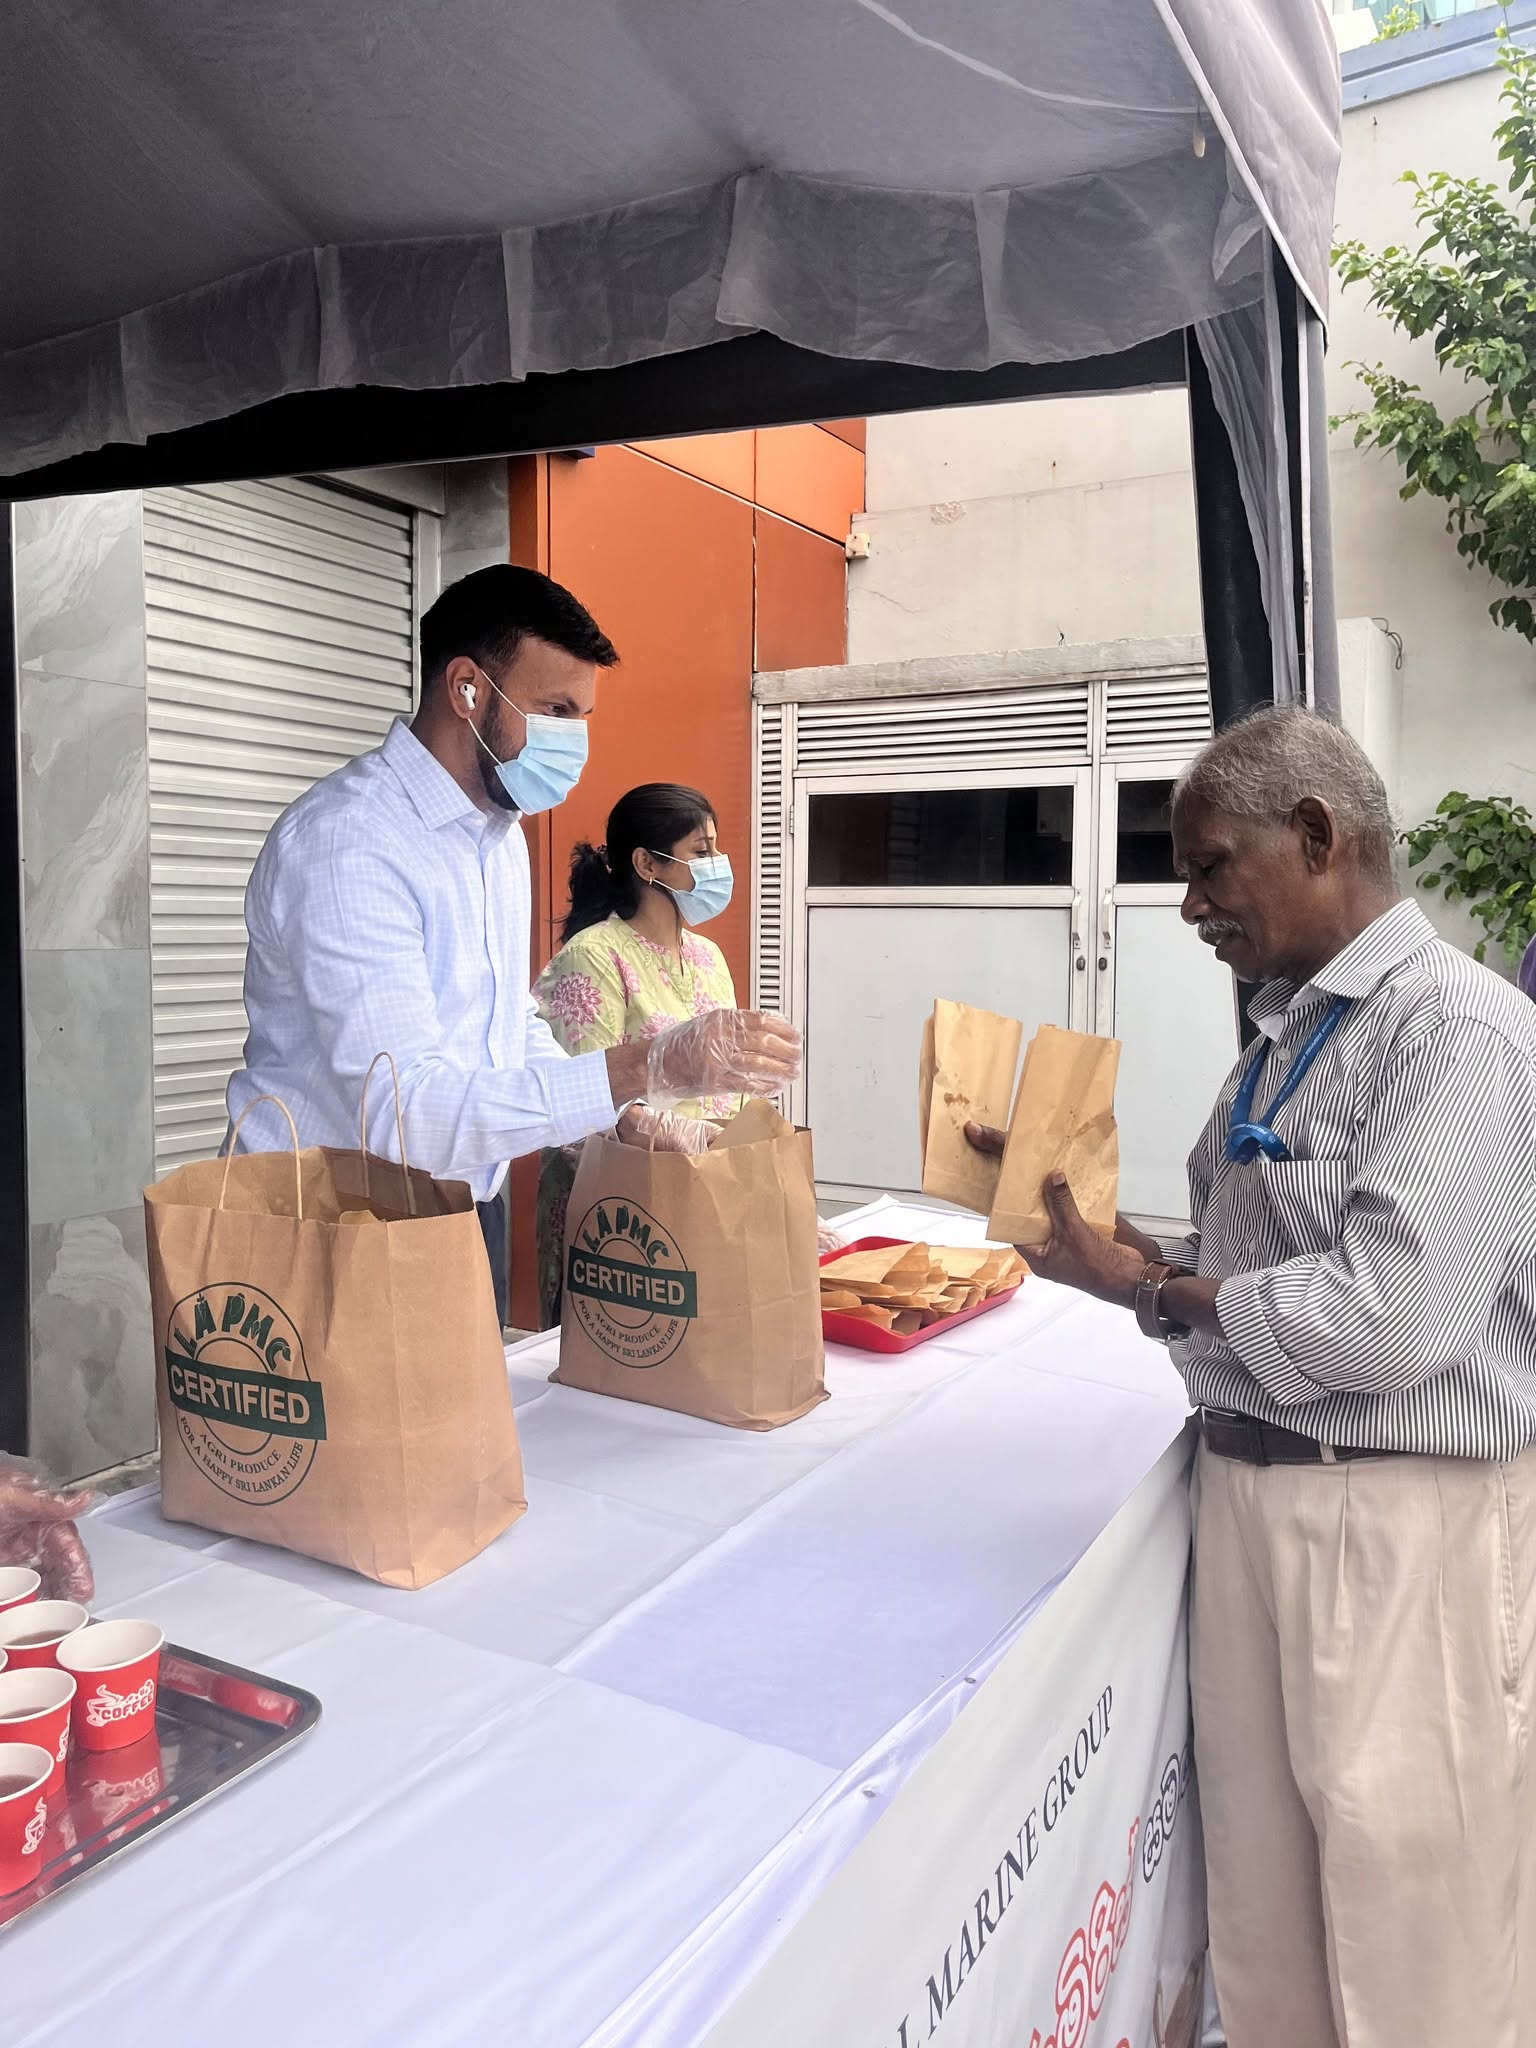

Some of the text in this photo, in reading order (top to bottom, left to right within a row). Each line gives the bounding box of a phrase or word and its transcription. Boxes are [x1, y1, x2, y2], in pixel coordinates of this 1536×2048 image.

[583, 1205, 670, 1266] LAPMC
[573, 1258, 685, 1306] CERTIFIED
[174, 1293, 291, 1371] LAPMC
[579, 1300, 679, 1358] FOR A HAPPY SRI LANKAN LIFE
[595, 1312, 660, 1343] AGRI PRODUCE
[171, 1365, 310, 1425] CERTIFIED
[181, 1416, 304, 1493] FOR A HAPPY SRI LANKAN LIFE
[200, 1434, 281, 1474] AGRI PRODUCE
[101, 1693, 154, 1720] COFFEE
[926, 1807, 1040, 2040] MARINE
[1043, 1685, 1113, 1832] GROUP
